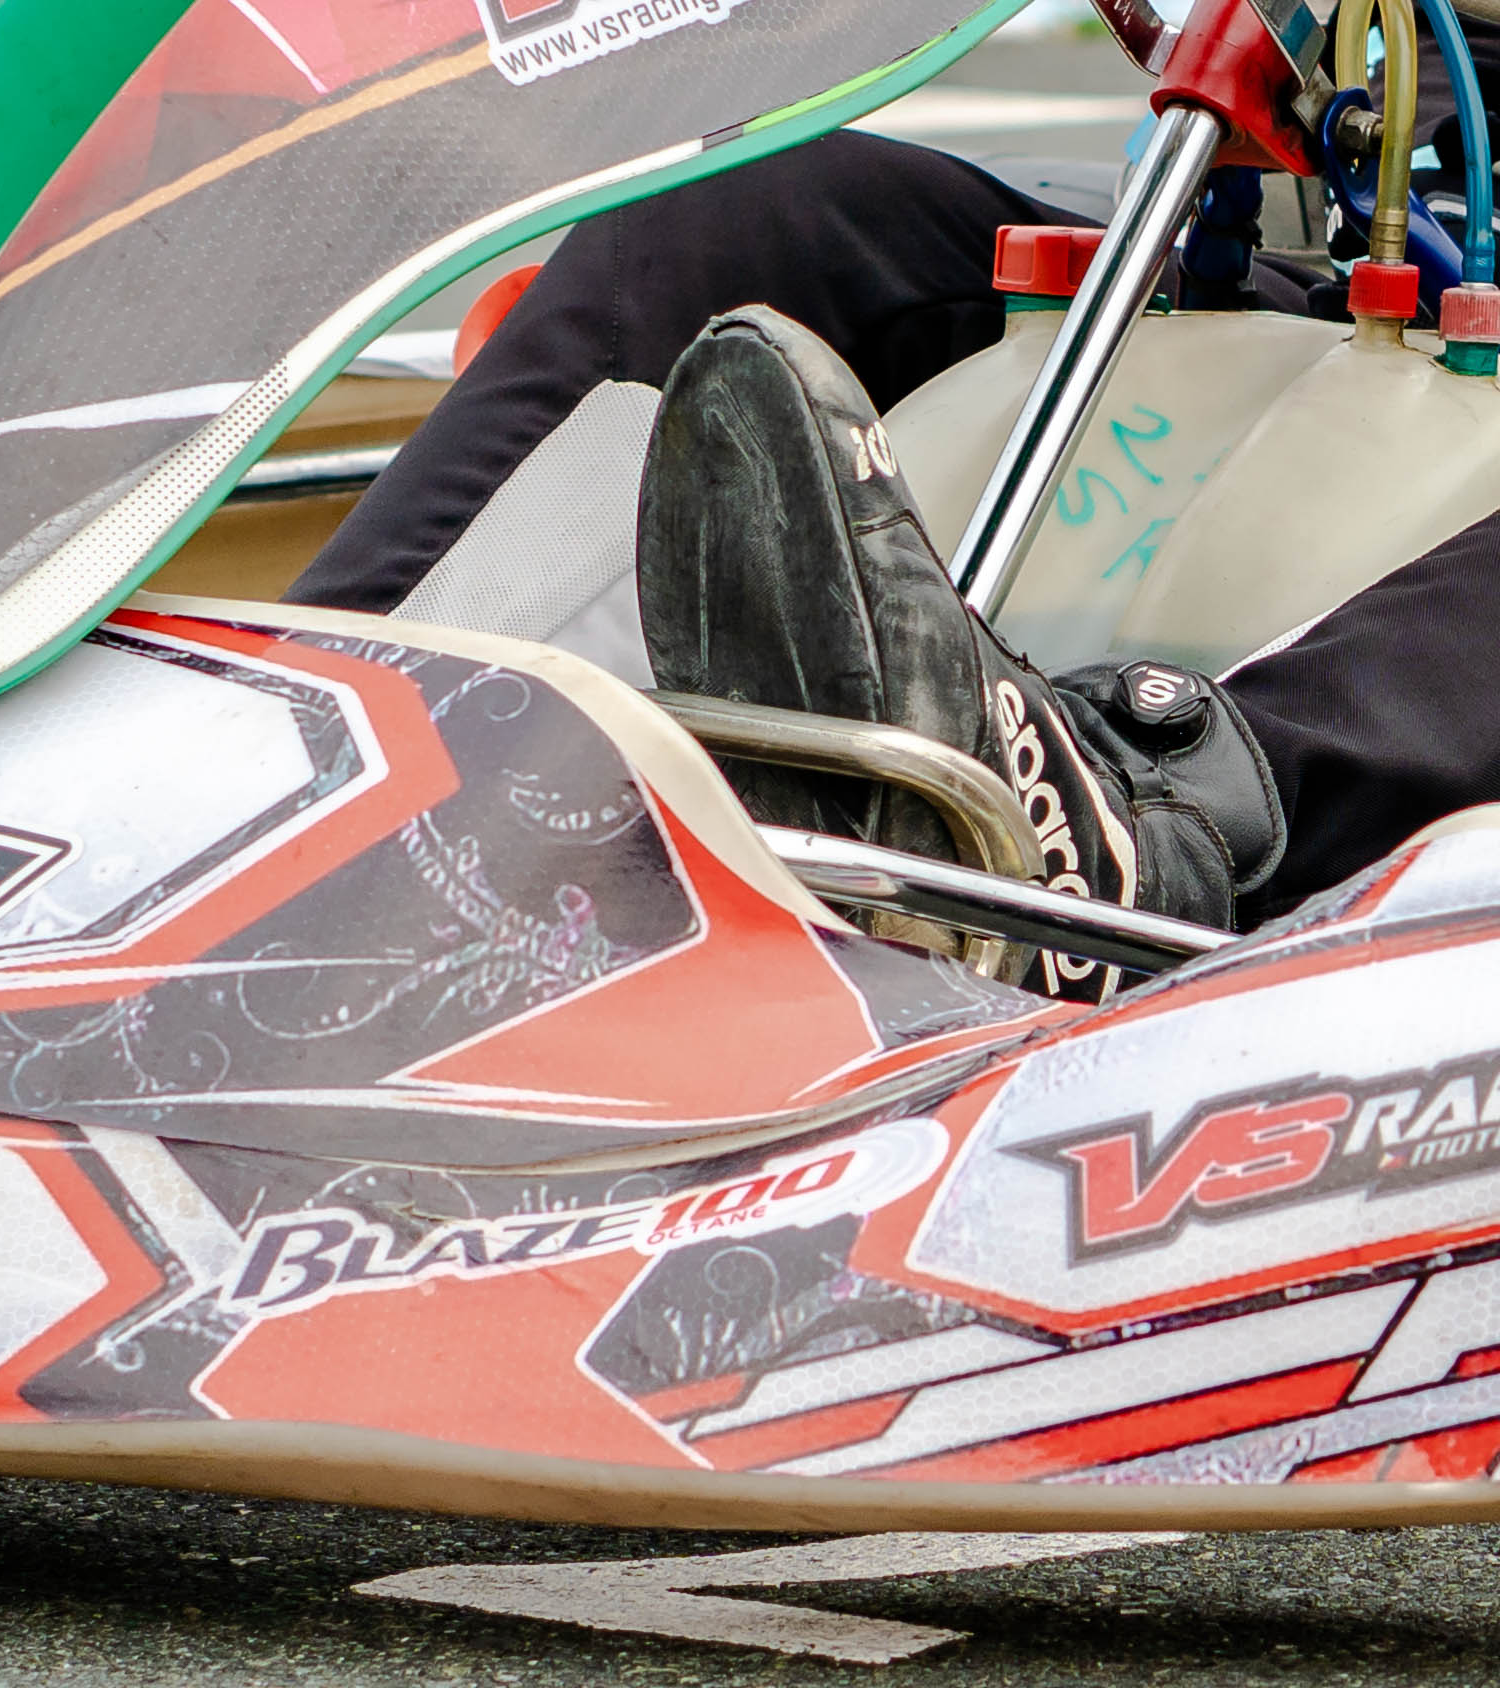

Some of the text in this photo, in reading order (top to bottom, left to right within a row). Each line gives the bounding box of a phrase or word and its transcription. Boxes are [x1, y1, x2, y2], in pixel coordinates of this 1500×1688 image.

[229, 1149, 864, 1310] BLAZE 100
[646, 1205, 767, 1247] OCTANE
[1060, 1089, 1353, 1244] VS
